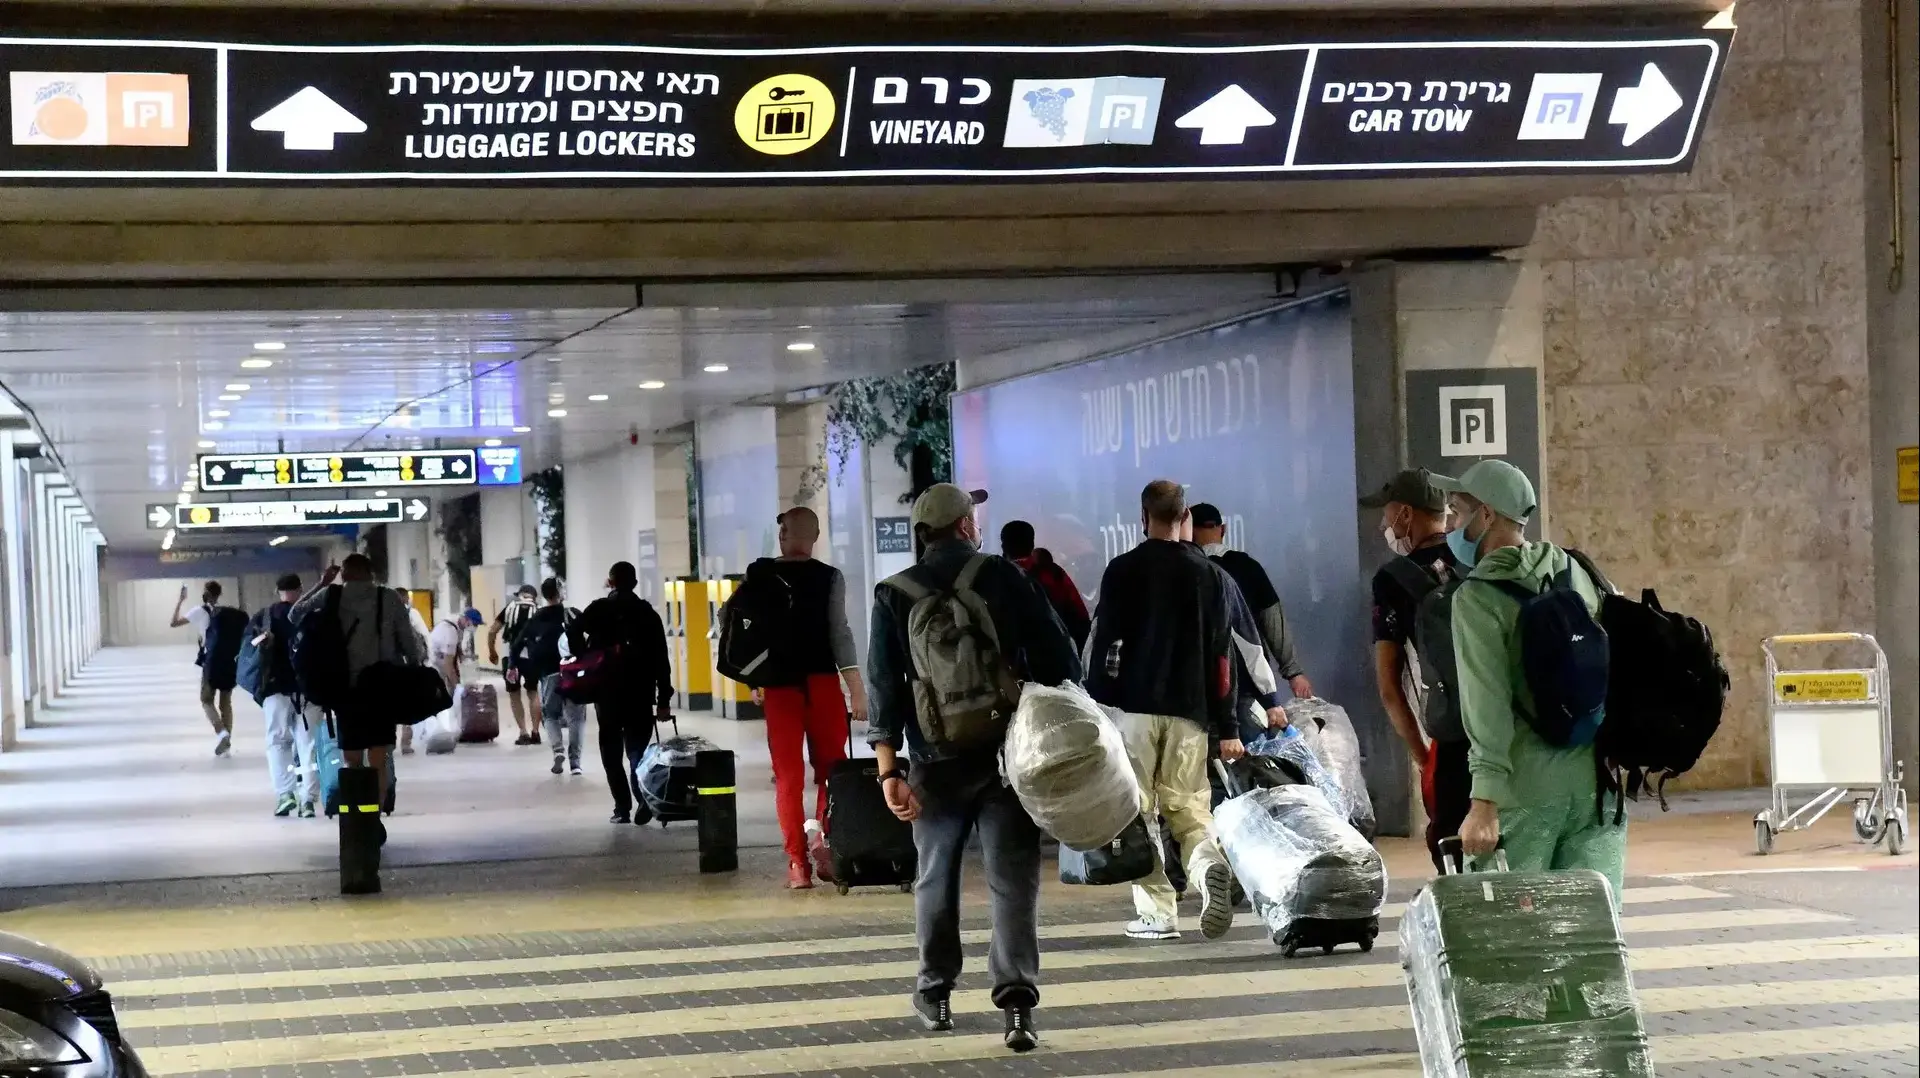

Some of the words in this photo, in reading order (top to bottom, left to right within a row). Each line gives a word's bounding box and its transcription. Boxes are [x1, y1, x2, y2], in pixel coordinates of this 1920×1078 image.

[388, 66, 535, 95] לשמירת
[544, 70, 646, 99] אחסון
[656, 71, 720, 96] תאי
[872, 77, 992, 105] כרם
[1321, 82, 1412, 104] רכבים
[1419, 81, 1511, 104] גרירת
[421, 101, 558, 126] ומזוודות
[570, 99, 683, 125] חפצים
[1348, 109, 1403, 133] CAR
[1410, 107, 1474, 132] TOW
[405, 132, 550, 159] LUGGAGE
[558, 131, 696, 158] LOCKERS
[869, 120, 985, 146] VINEYARD
[1164, 365, 1212, 443] חדש
